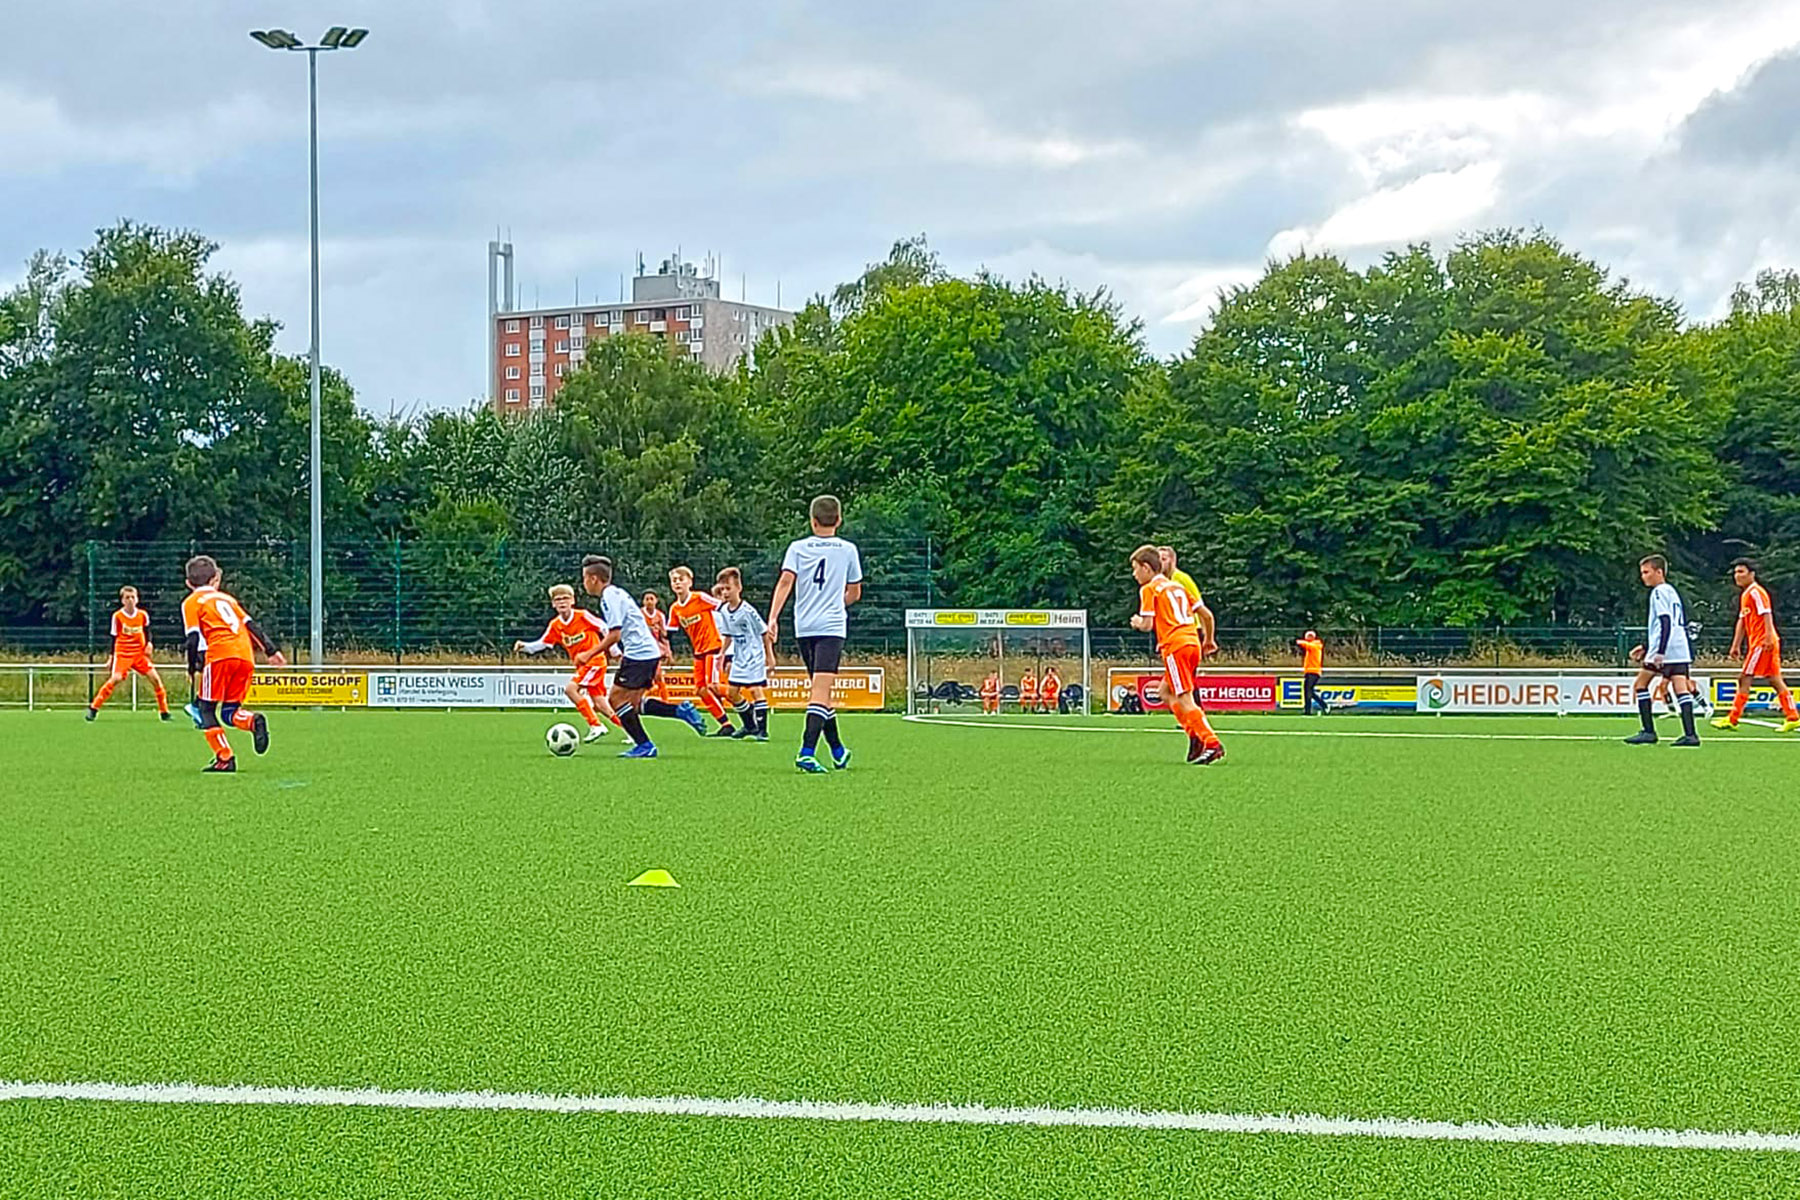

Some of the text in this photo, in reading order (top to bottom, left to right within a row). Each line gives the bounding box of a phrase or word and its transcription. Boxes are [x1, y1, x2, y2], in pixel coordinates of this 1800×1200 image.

[813, 558, 826, 591] 4
[215, 599, 239, 635] 9
[1054, 614, 1082, 624] Heim
[251, 676, 307, 686] ELEKTRO
[399, 677, 485, 688] FLIESEN WEISS
[1219, 687, 1272, 699] HEROLD
[1453, 684, 1559, 705] HEIDJER
[1578, 684, 1667, 705] AREA
